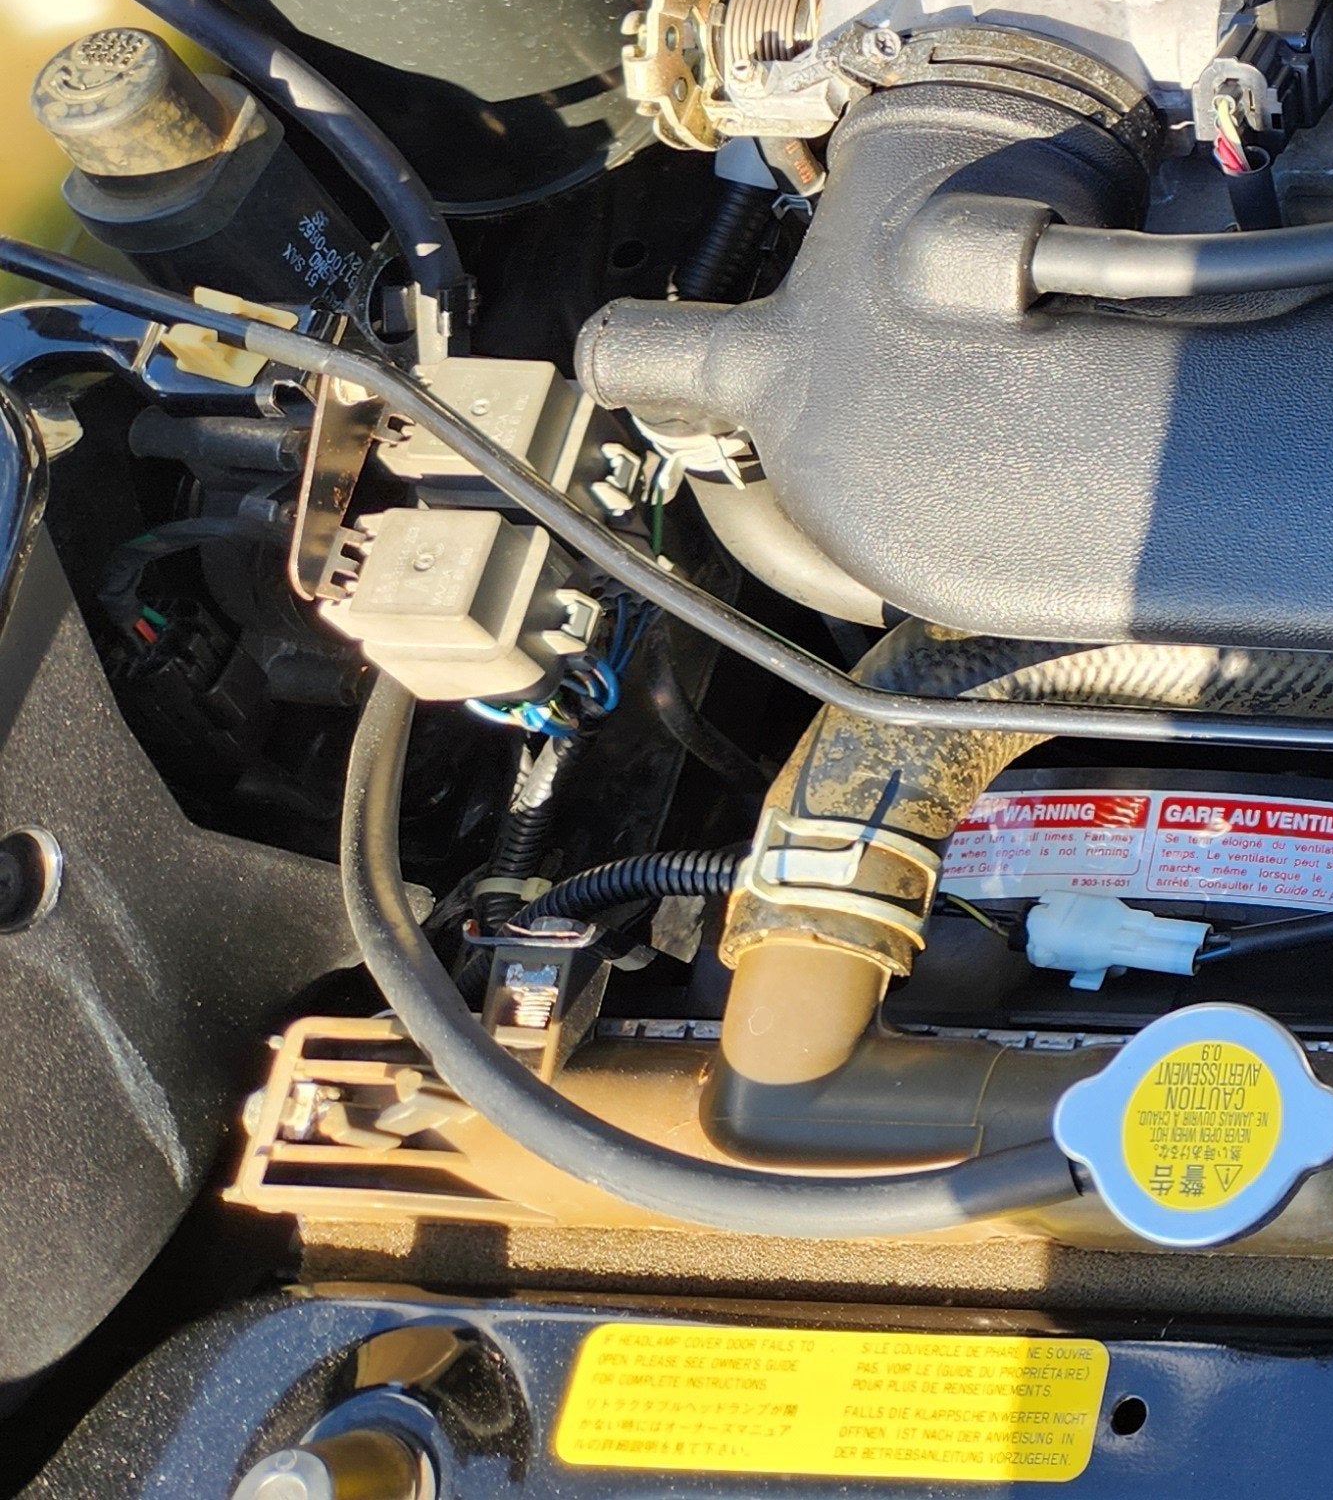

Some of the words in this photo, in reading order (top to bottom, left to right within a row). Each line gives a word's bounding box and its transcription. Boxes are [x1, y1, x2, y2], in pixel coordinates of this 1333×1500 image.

[1005, 803, 1095, 822] WARNING
[1165, 805, 1224, 825] GARE
[1229, 808, 1261, 827] AU
[975, 834, 985, 844] of
[1084, 832, 1105, 841] Fan
[1111, 833, 1134, 843] may
[1165, 834, 1179, 844] Se
[1188, 834, 1214, 846] tenir
[1272, 840, 1285, 850] du
[961, 851, 987, 859] when
[996, 849, 1031, 861] engine
[1040, 847, 1049, 856] is
[1059, 847, 1076, 856] not
[1207, 850, 1220, 860] Le
[1228, 852, 1288, 866] ventilateur
[1294, 857, 1319, 868] peut
[1159, 863, 1200, 874] marche
[1212, 865, 1248, 876] même
[1259, 868, 1301, 882] lorsque
[1312, 873, 1322, 882] le
[1199, 880, 1254, 891] Consulter
[1257, 883, 1268, 892] le
[1274, 884, 1308, 896] Guide
[1312, 888, 1326, 897] du
[1202, 1044, 1221, 1061] 0.9
[1155, 1063, 1262, 1086] AVERTISSEMENT
[1165, 1087, 1245, 1110] CAUTION
[1183, 1111, 1216, 1126] OUVRIR
[1219, 1112, 1254, 1126] JAMAIS
[1256, 1112, 1269, 1127] NE
[1172, 1128, 1197, 1142] WHEN
[1200, 1128, 1222, 1142] OPEN
[1225, 1128, 1251, 1143] NEVER
[1150, 1164, 1206, 1196] 警告
[619, 1335, 681, 1346] HEADLAMP
[684, 1337, 721, 1349] COVER
[726, 1338, 757, 1350] DOOR
[761, 1339, 794, 1351] FAILS
[800, 1340, 815, 1352] TO
[874, 1343, 889, 1355] LE
[893, 1344, 961, 1358] COUVERCLE
[965, 1346, 980, 1358] DE
[983, 1346, 1020, 1359] PHARE
[1026, 1346, 1041, 1359] NE
[634, 1355, 677, 1367] PLEASE
[683, 1357, 704, 1368] SEE
[766, 1360, 799, 1371] GUIDE
[887, 1363, 912, 1375] VOIR
[916, 1364, 930, 1376] LE
[978, 1365, 995, 1378] DU
[593, 1372, 614, 1384] FOR
[618, 1374, 681, 1388] COMPLETE
[852, 1379, 883, 1391] POUR
[886, 1380, 916, 1392] PLUS
[921, 1381, 937, 1393] DE
[843, 1405, 884, 1419] FALLS
[888, 1406, 910, 1420] DIE
[1053, 1411, 1088, 1426] NICHT
[896, 1427, 917, 1440] IST
[921, 1427, 954, 1441] NACH
[957, 1429, 980, 1443] DER
[986, 1428, 1053, 1445] ANWEISUNG
[1061, 1432, 1075, 1445] IN
[834, 1446, 856, 1459] DER
[861, 1447, 984, 1464] BETRIEBSANLEITUNG
[989, 1450, 1072, 1465] VORZUGEHEN.
